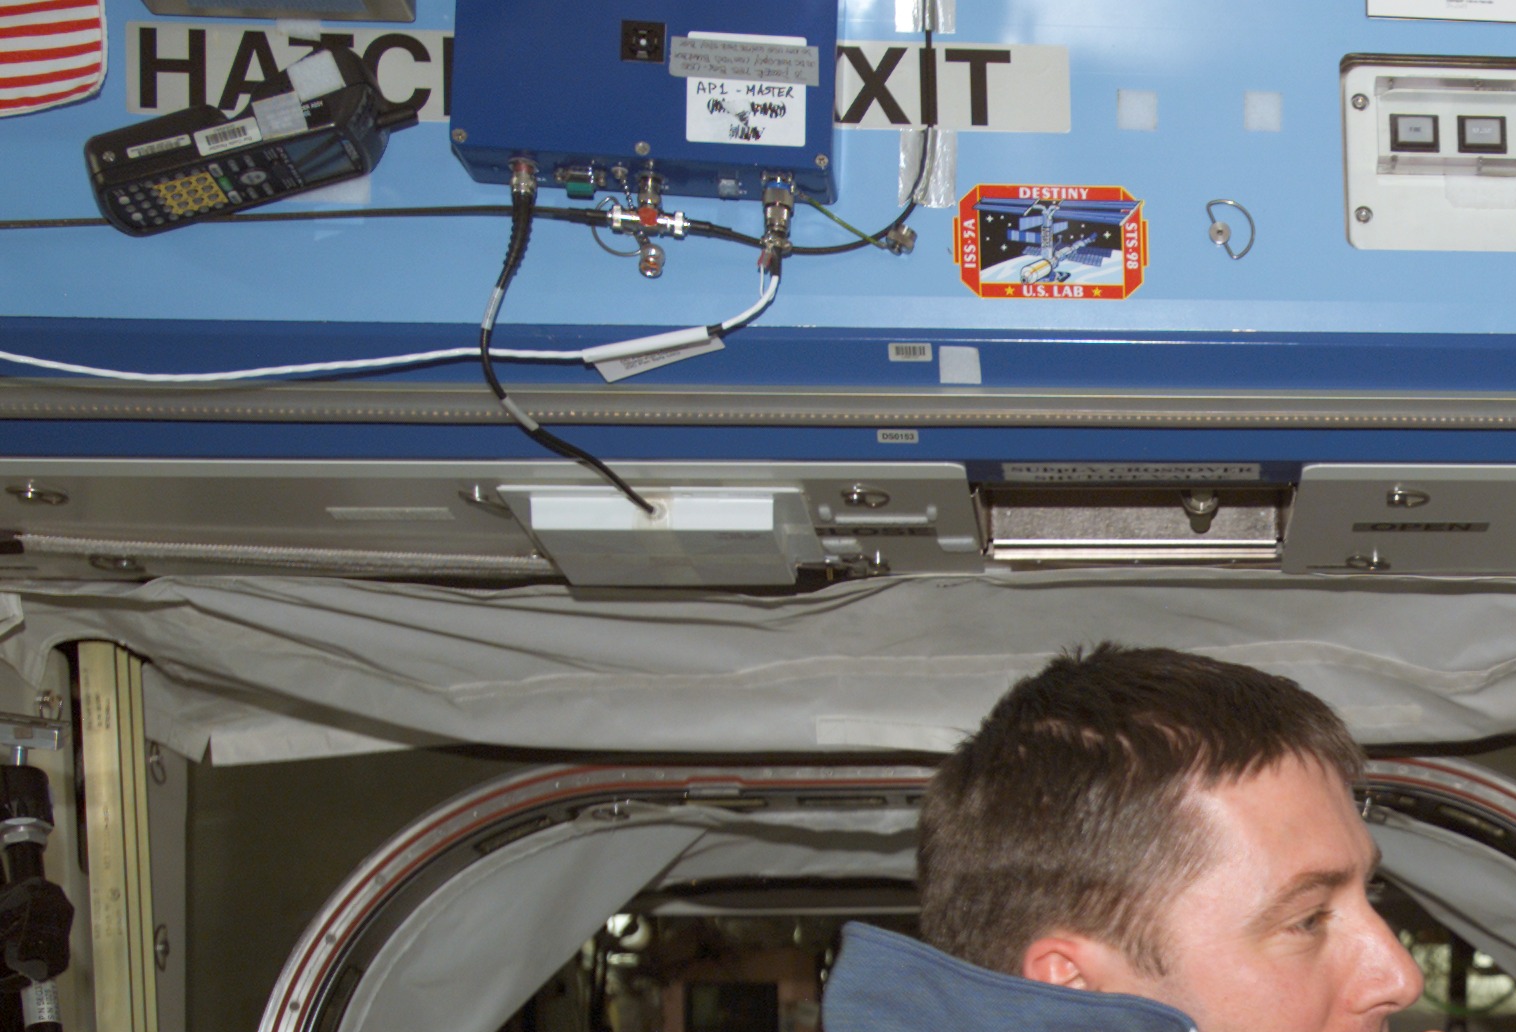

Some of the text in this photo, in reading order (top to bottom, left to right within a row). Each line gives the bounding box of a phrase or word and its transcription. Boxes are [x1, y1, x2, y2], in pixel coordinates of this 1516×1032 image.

[139, 27, 454, 116] HAC
[836, 46, 1011, 127] XIT
[743, 84, 795, 99] MASTER
[1018, 187, 1089, 200] DESTINY
[1022, 284, 1084, 298] U.S. LAB
[1369, 522, 1472, 532] OPEN
